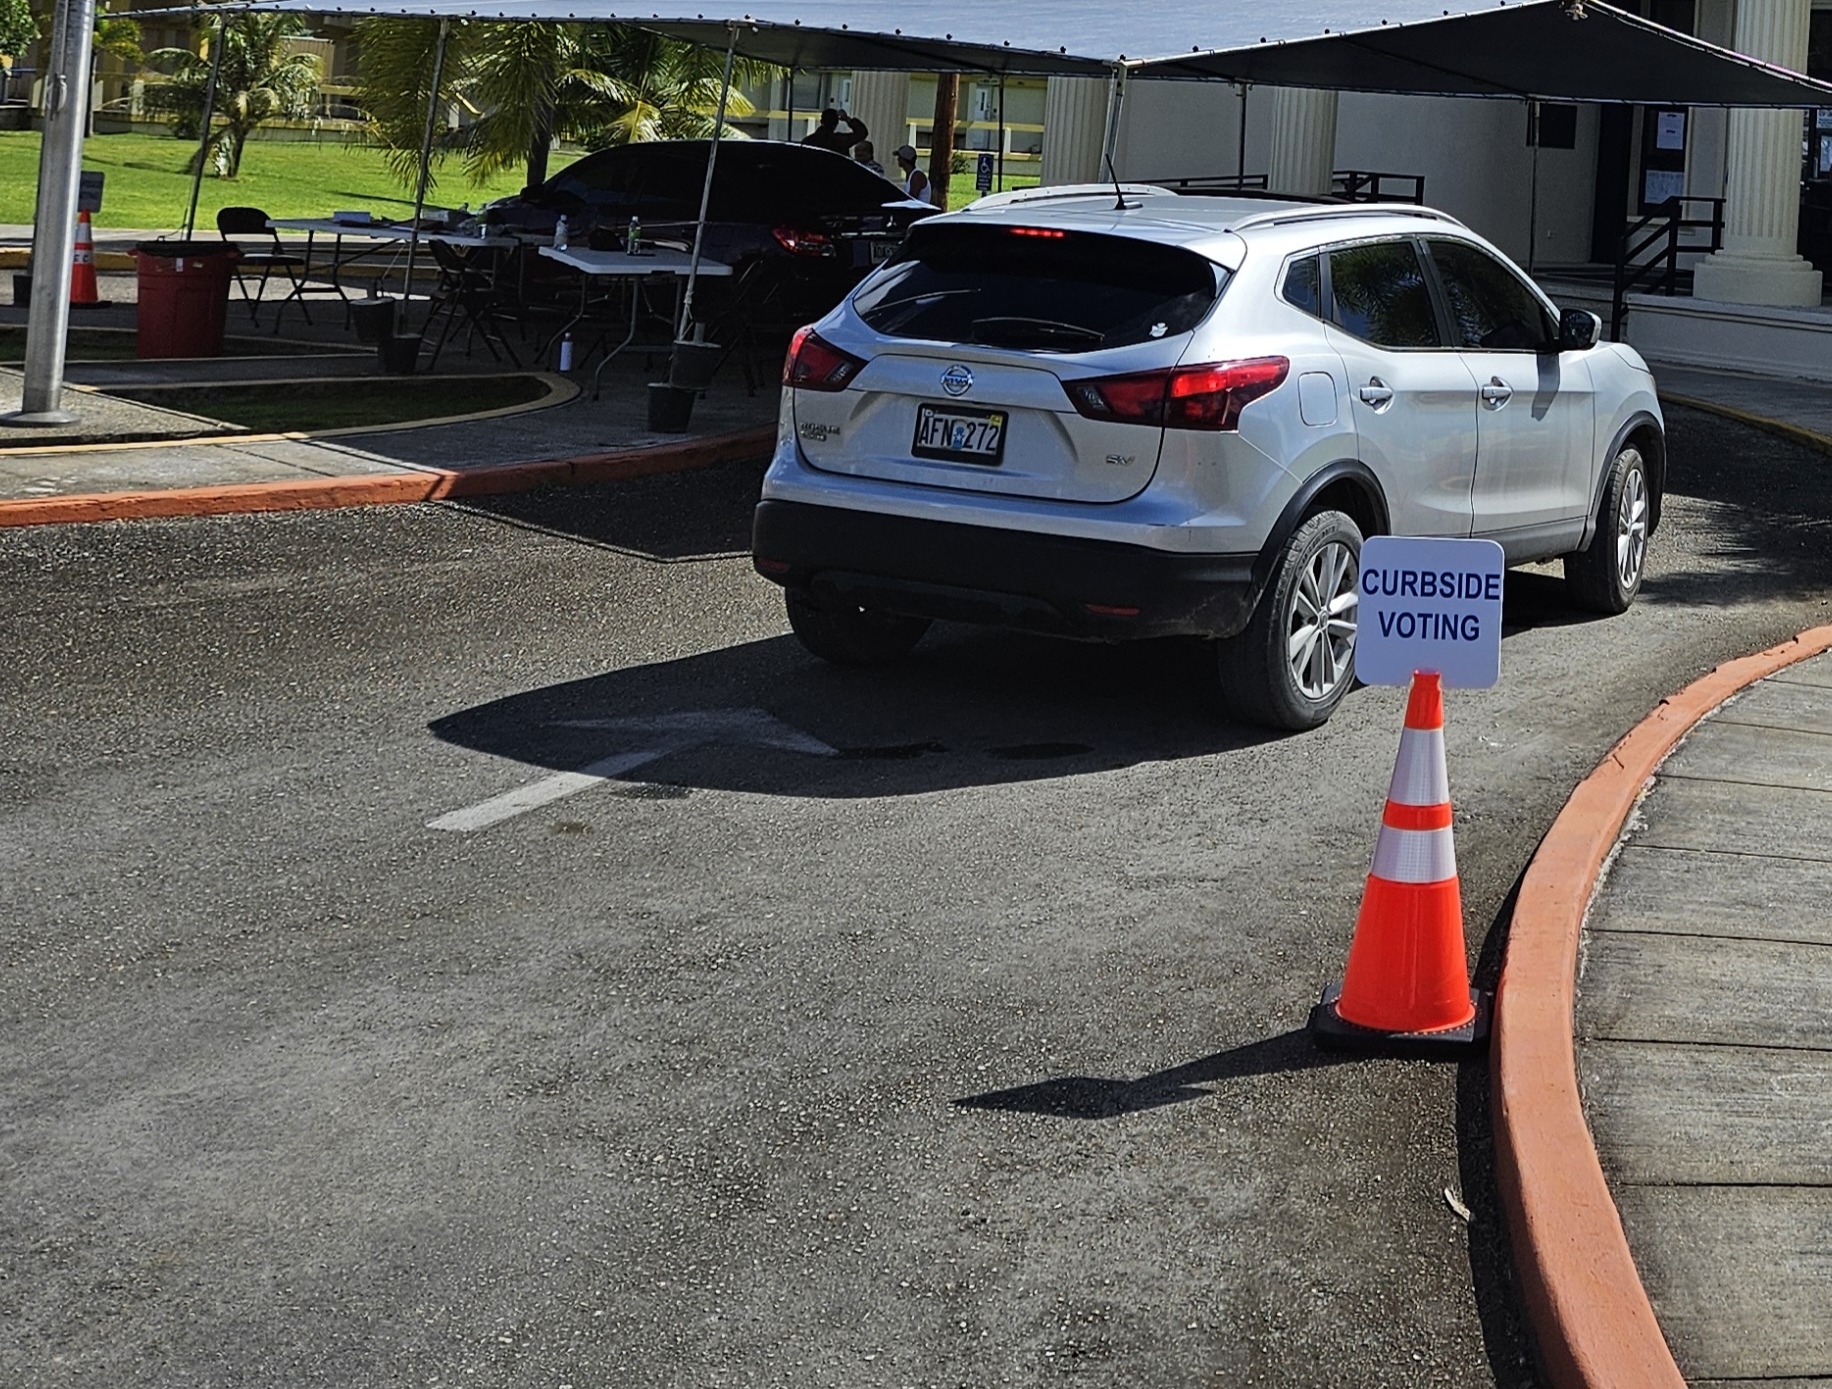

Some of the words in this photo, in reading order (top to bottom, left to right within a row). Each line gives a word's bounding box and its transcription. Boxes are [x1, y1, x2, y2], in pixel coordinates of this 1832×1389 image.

[918, 416, 955, 447] AFN
[962, 421, 1000, 452] 272
[1105, 454, 1136, 467] SV
[1361, 568, 1501, 601] CURBSIDE
[1378, 611, 1480, 642] VOTING
